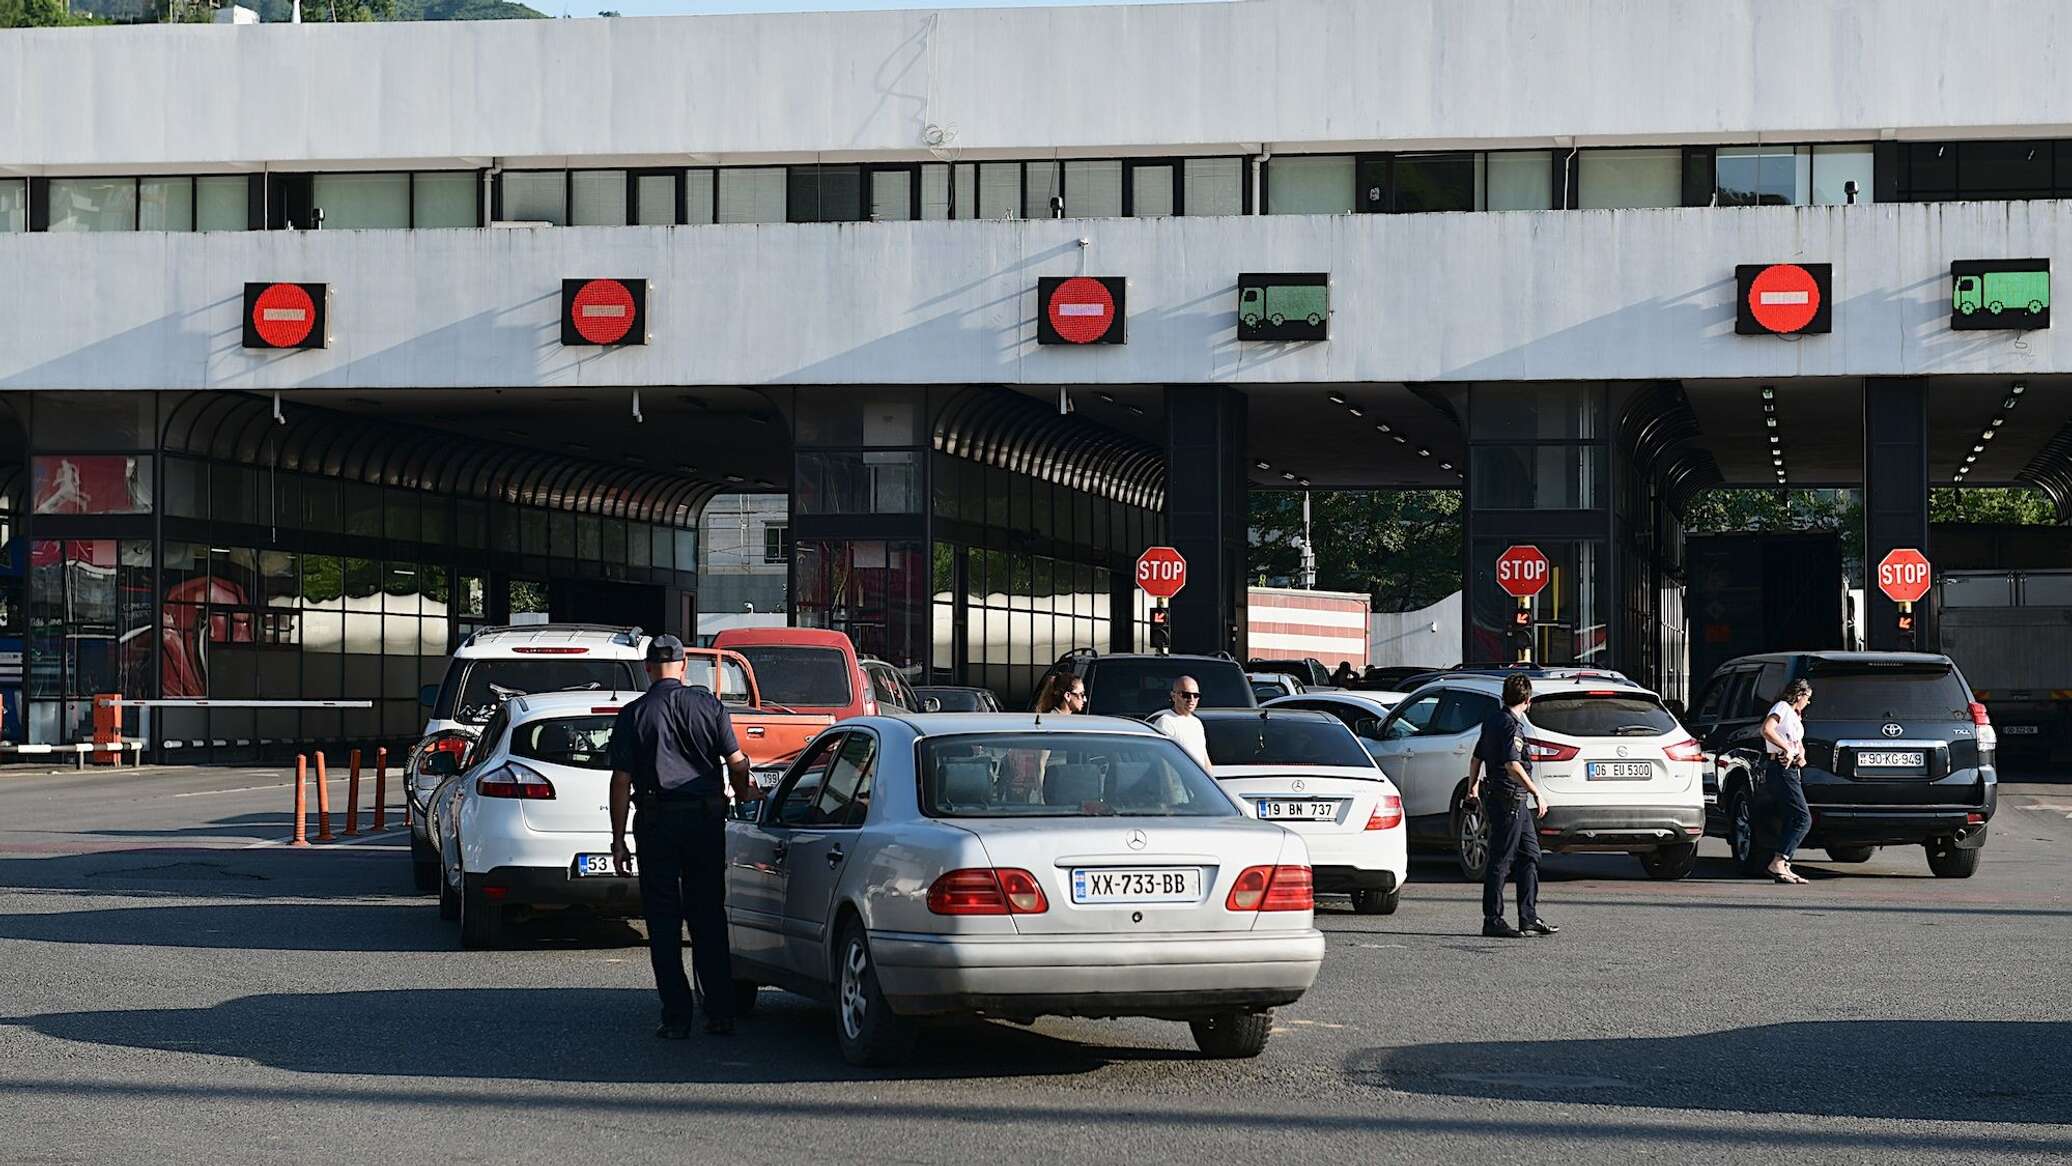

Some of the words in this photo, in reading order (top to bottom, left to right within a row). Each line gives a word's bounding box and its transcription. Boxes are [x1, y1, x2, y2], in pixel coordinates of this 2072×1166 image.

[1139, 560, 1183, 580] STOP
[1500, 560, 1546, 580] STOP
[1881, 563, 1927, 585] STOP
[1595, 764, 1607, 776] 06
[1613, 764, 1625, 776] EU
[1627, 764, 1650, 776] 5300
[1267, 803, 1281, 816] 19
[1289, 803, 1303, 816] BN
[1311, 803, 1332, 816] 737
[588, 856, 608, 871] 53
[1091, 873, 1186, 896] XX-733-BB
